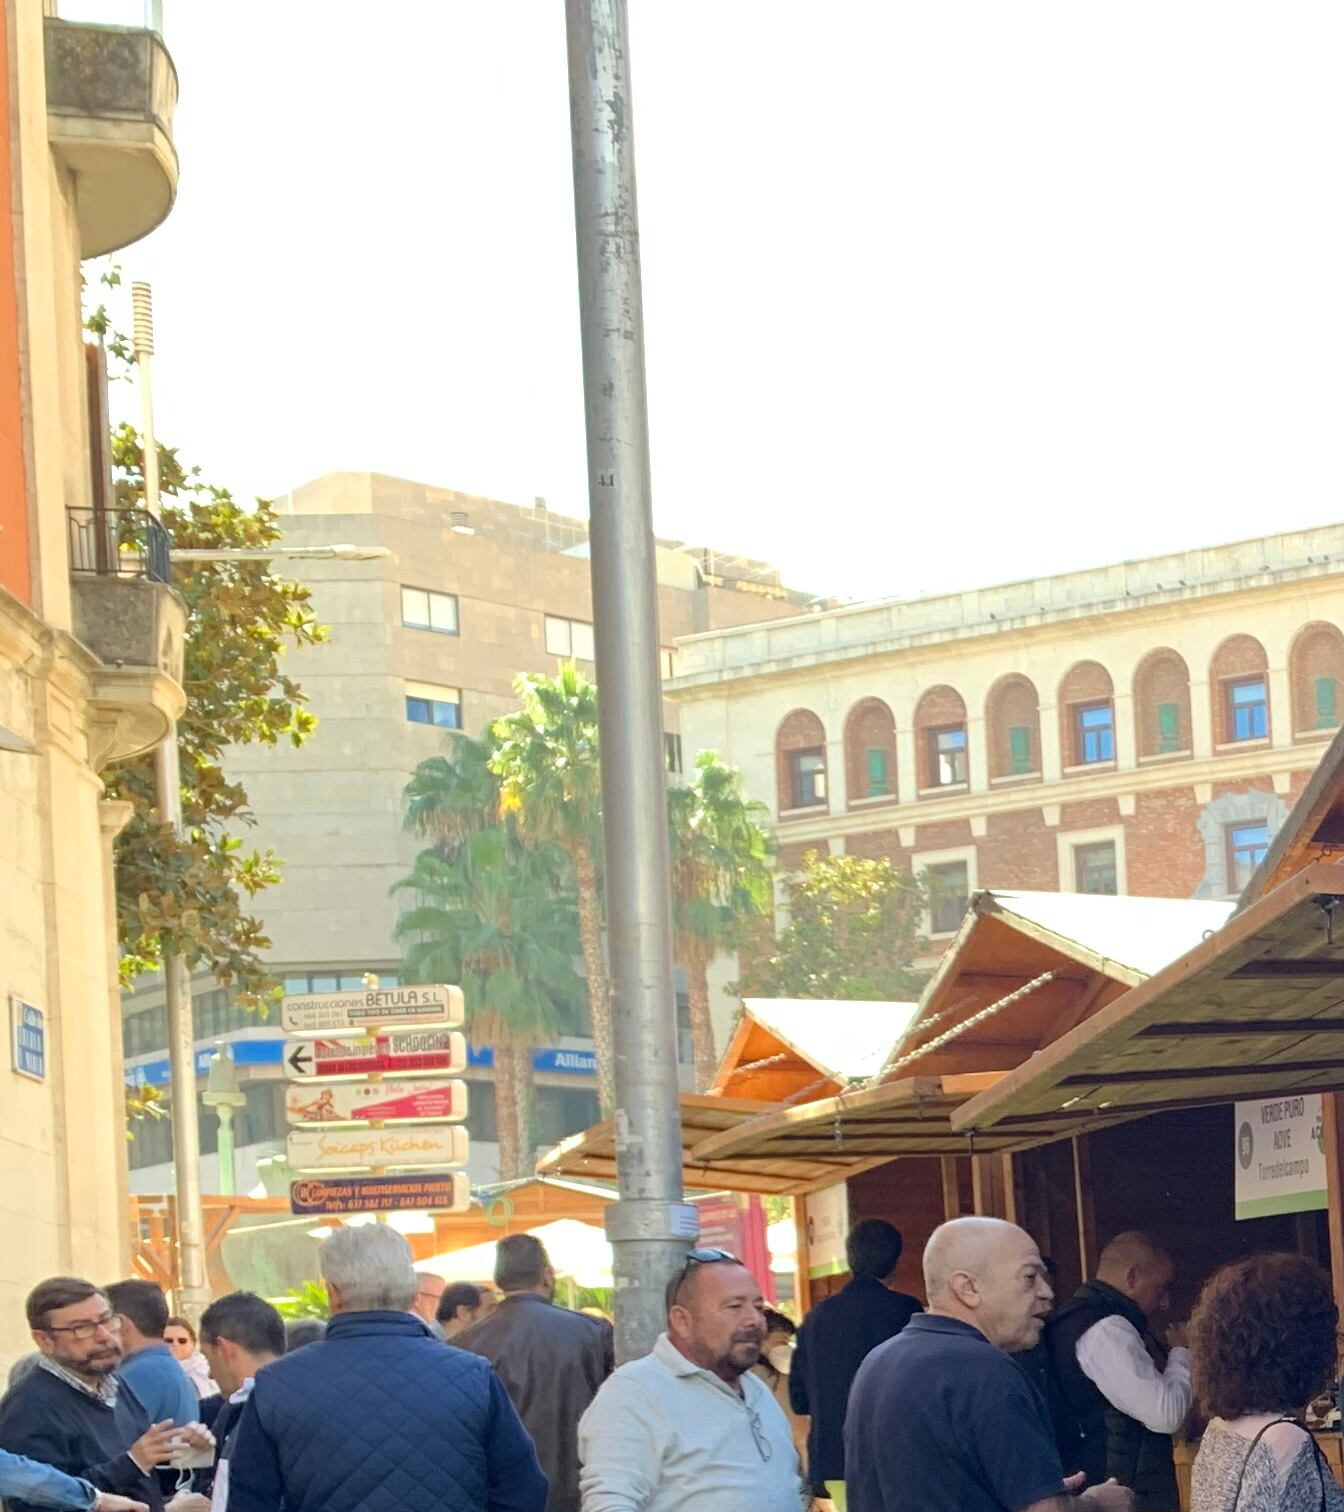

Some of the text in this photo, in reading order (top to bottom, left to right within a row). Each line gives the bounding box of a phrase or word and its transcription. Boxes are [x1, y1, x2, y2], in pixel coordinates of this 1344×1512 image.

[287, 998, 364, 1012] construcciones
[365, 990, 418, 1007] BETULA
[555, 1053, 597, 1070] Allian
[1261, 1097, 1305, 1125] VERDE PURO
